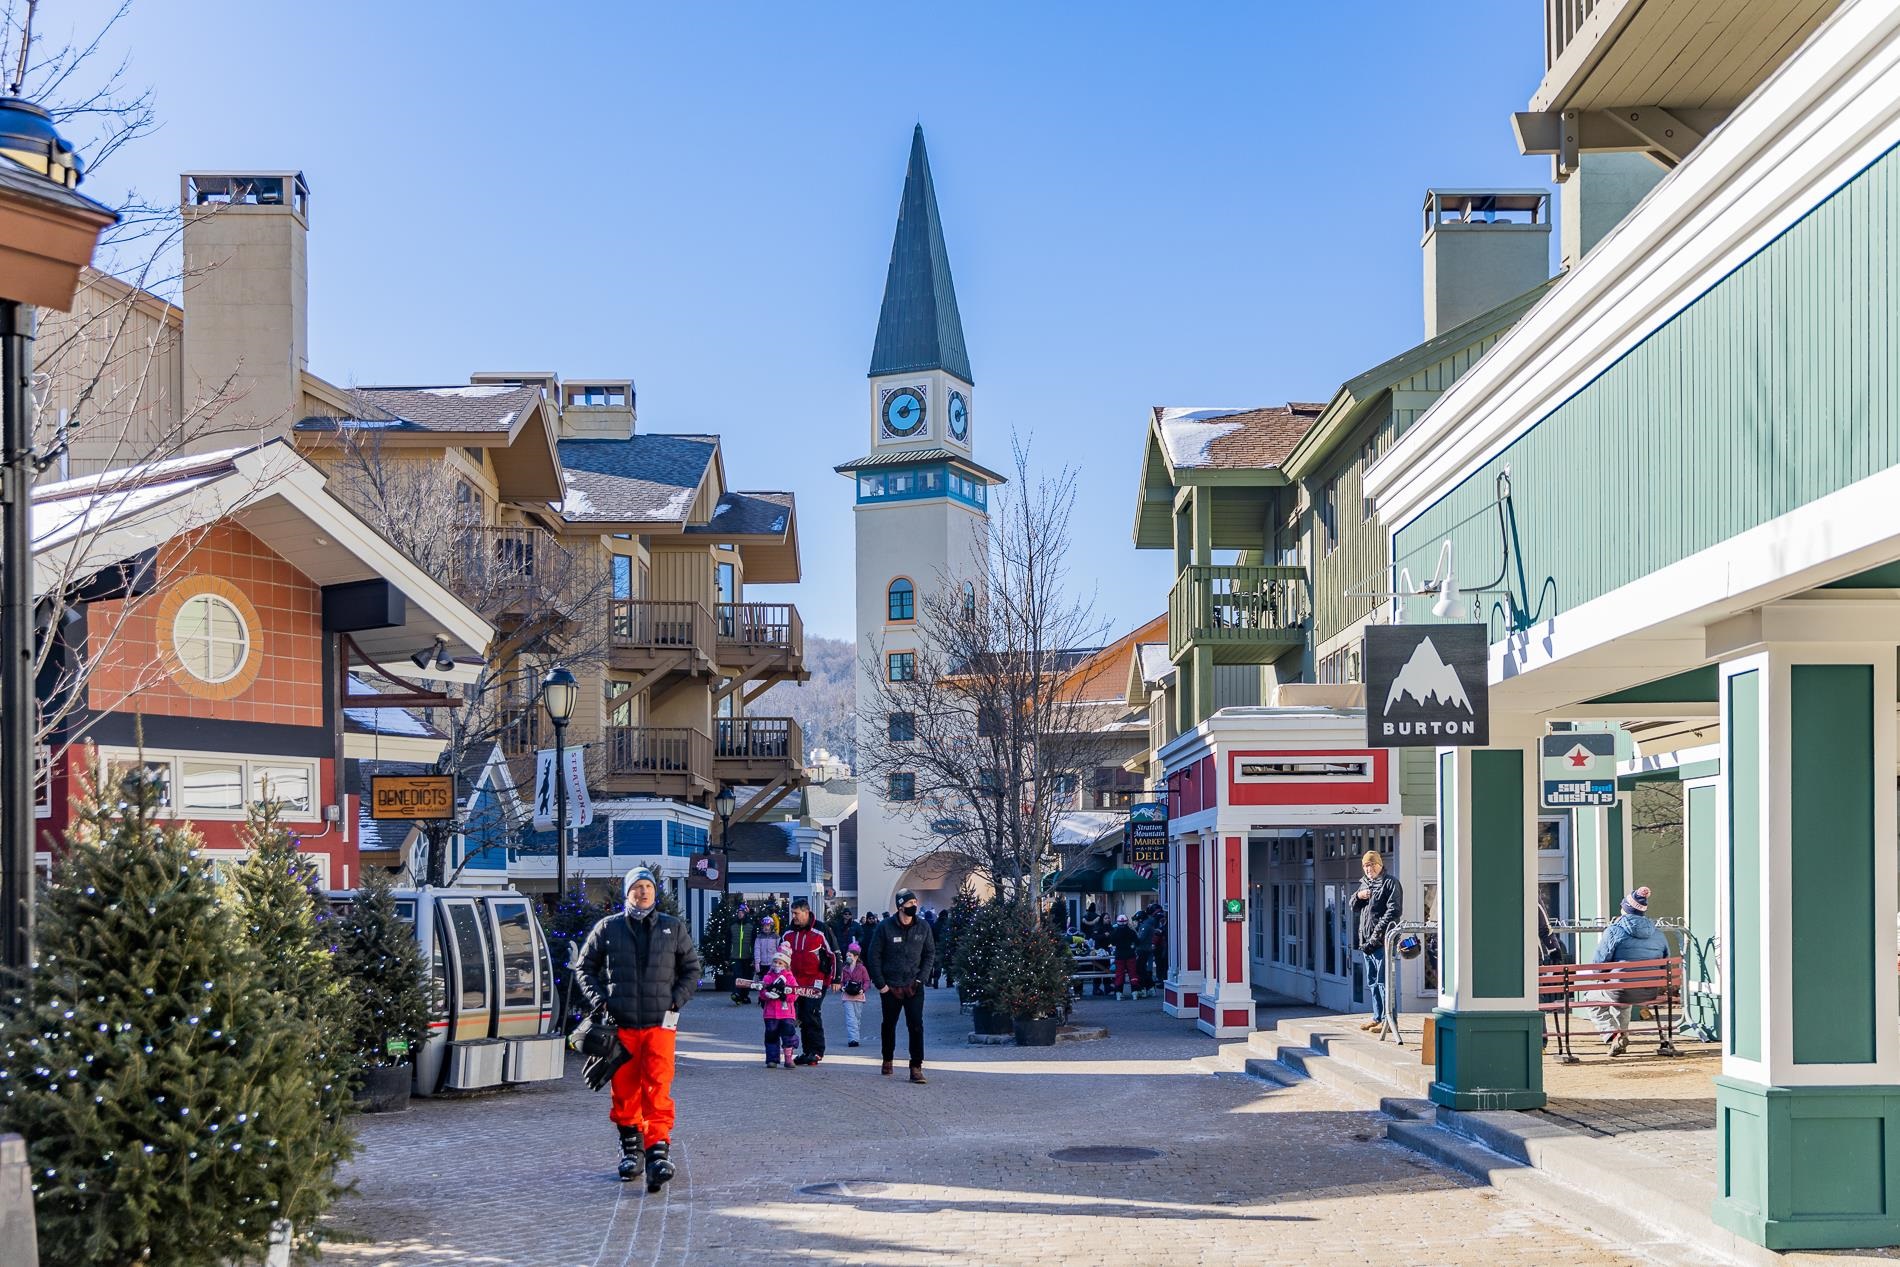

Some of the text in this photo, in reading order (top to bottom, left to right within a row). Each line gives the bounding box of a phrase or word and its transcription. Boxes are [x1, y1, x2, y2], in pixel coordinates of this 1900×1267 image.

[1383, 721, 1475, 735] BURTON
[572, 752, 586, 808] STRATTON
[1558, 781, 1613, 795] syd and
[378, 789, 447, 806] BENEDICTS
[1547, 791, 1613, 805] dusty's
[1134, 830, 1165, 838] Mountain
[1134, 838, 1165, 846] MARKET
[1135, 851, 1164, 861] DELI
